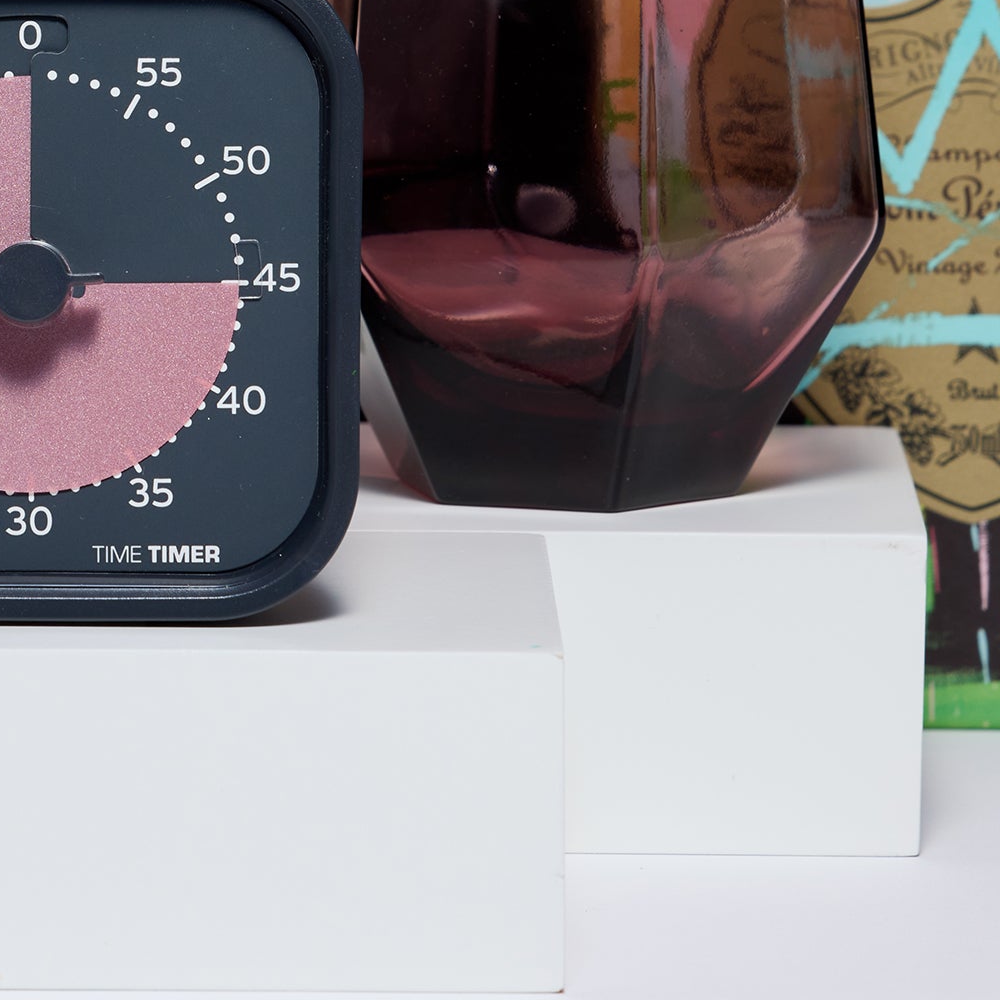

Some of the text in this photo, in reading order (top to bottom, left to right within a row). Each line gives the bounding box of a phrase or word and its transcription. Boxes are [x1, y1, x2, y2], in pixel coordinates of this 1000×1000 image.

[18, 20, 42, 50] 0
[136, 57, 182, 88] 55
[222, 145, 271, 176] 50
[252, 262, 301, 293] 45
[216, 384, 266, 416] 40
[128, 477, 174, 508] 35
[5, 505, 53, 536] 30
[91, 544, 221, 564] TIME TIMER
